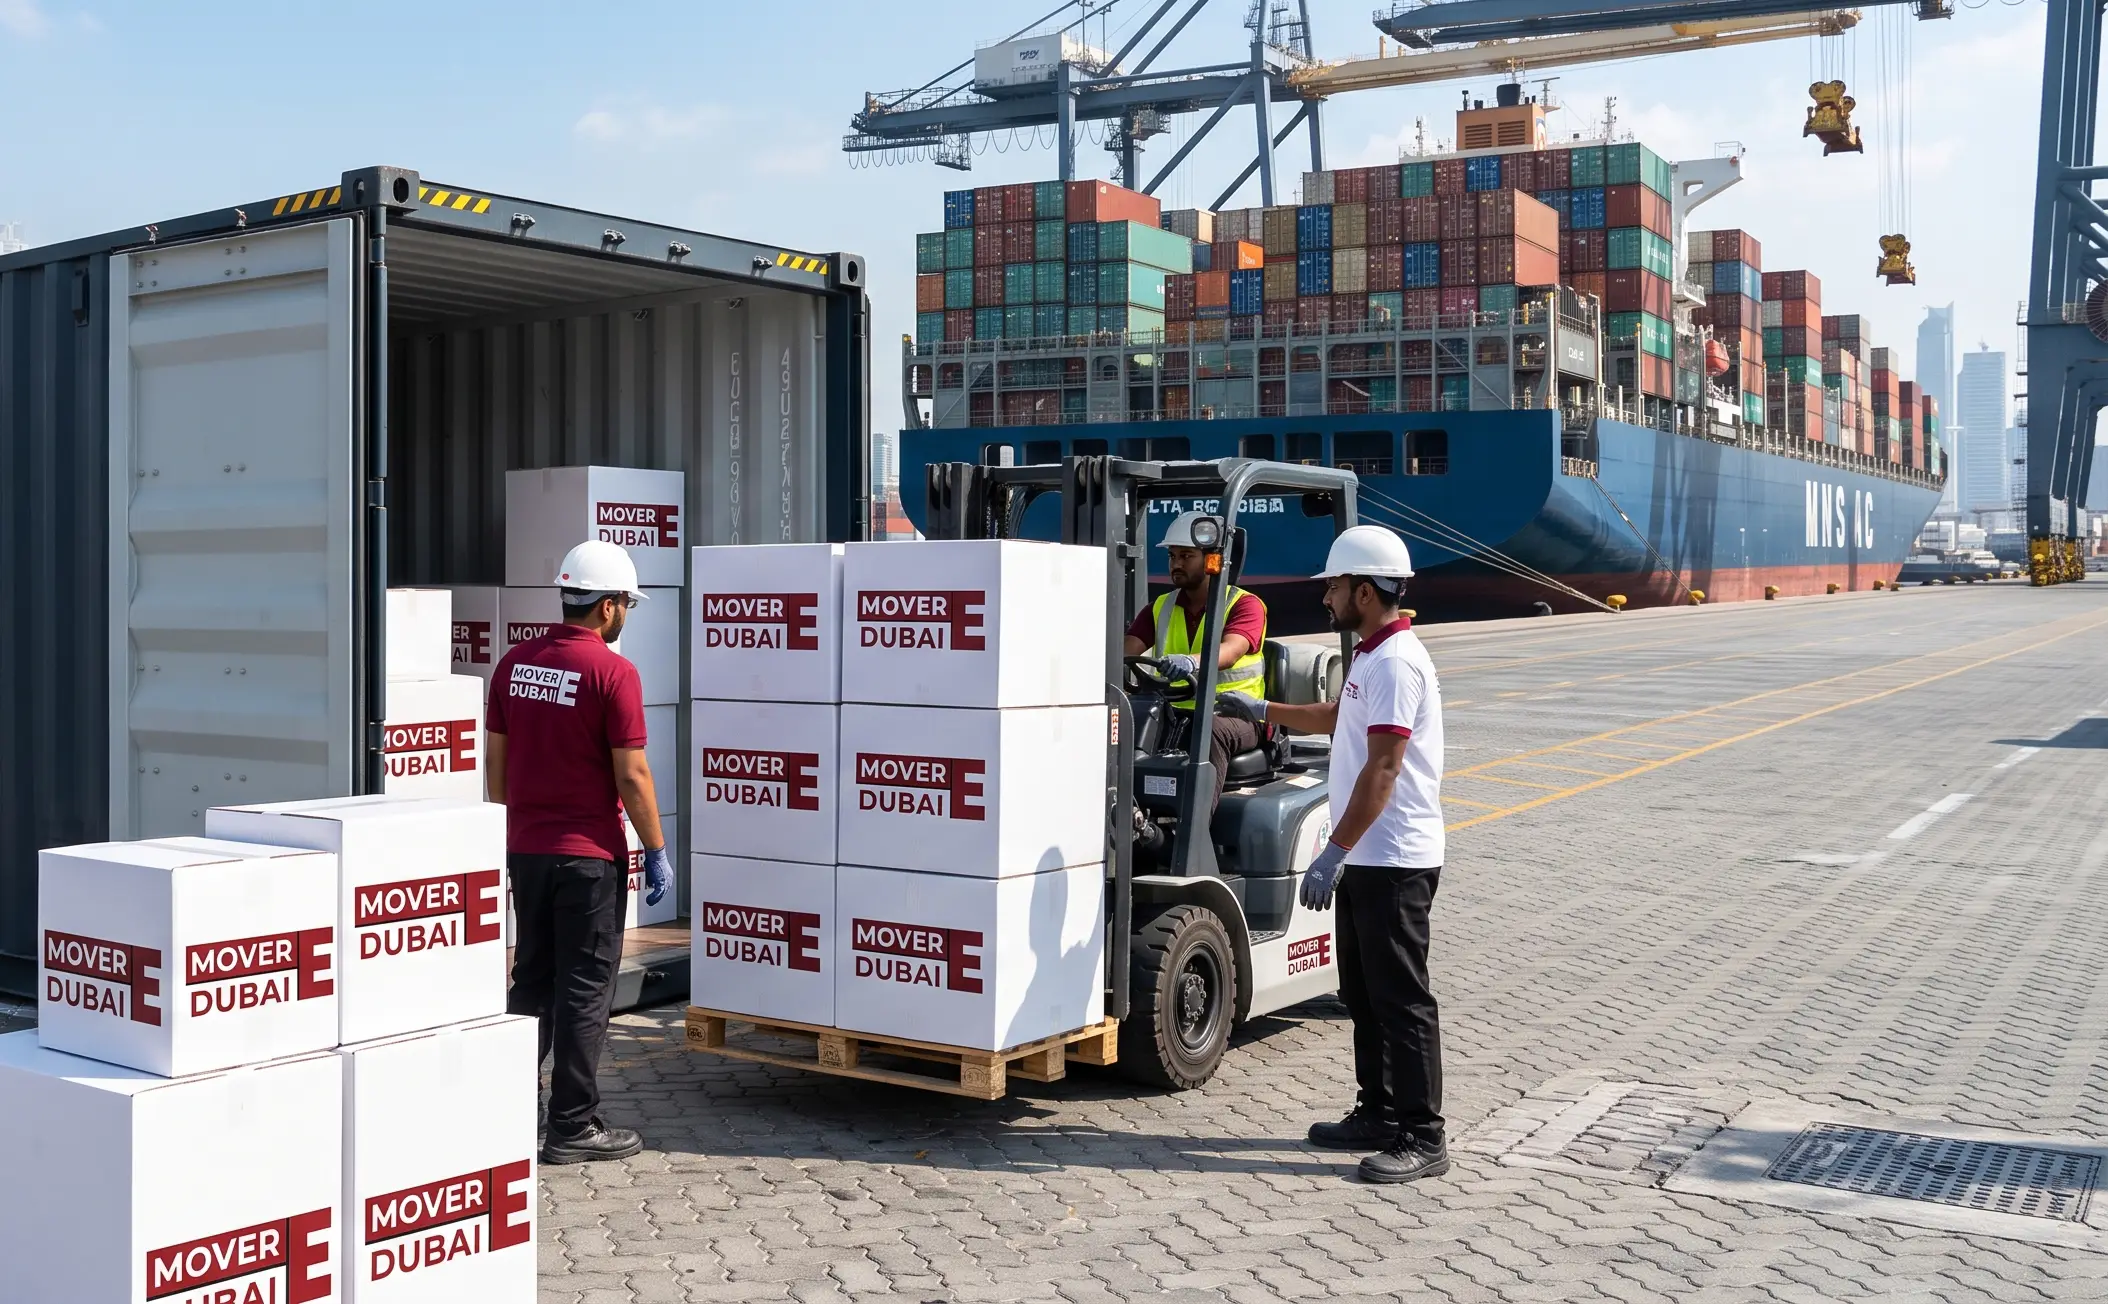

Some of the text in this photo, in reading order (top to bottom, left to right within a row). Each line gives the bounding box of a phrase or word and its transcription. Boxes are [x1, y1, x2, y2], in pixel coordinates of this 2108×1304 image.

[600, 506, 656, 523] MOVER
[1148, 499, 1182, 513] LTA
[1806, 480, 1873, 549] MNS AC
[599, 529, 654, 547] DUBAI
[658, 505, 678, 547] E
[707, 599, 783, 618] MOVER
[787, 593, 818, 650] E
[862, 596, 947, 616] MOVER
[950, 590, 985, 651] E
[706, 628, 781, 649] DUBAI
[860, 626, 943, 649] DUBAI
[514, 667, 559, 684] MOVER
[450, 719, 476, 772] E
[384, 754, 444, 777] UBAI
[707, 754, 784, 777] MOVER
[788, 752, 819, 811] E
[861, 759, 946, 783] MOVER
[706, 782, 781, 807] DUBAI
[860, 790, 942, 816] DUBAI
[950, 758, 985, 820] E
[360, 880, 459, 919] MOVER
[465, 869, 500, 945] E
[360, 920, 457, 959] DUBAI
[707, 908, 784, 934] MOVER
[857, 925, 943, 954] MOVER
[48, 937, 127, 975] MOVER
[192, 939, 293, 976] MOVER
[706, 938, 781, 966] DUBAI
[788, 911, 820, 972] E
[1290, 939, 1318, 957] MOVER
[1319, 933, 1330, 966] E
[299, 927, 334, 1001] E
[856, 956, 940, 987] DUBAI
[947, 929, 983, 994] E
[1289, 956, 1317, 975] DUBAI
[47, 976, 124, 1017] DUBAI
[131, 946, 162, 1027] E
[191, 977, 290, 1017] DUBAI
[372, 1180, 483, 1232] MOVER
[490, 1159, 530, 1252] E
[154, 1228, 280, 1288] MOVER
[371, 1224, 480, 1282] DUBAI
